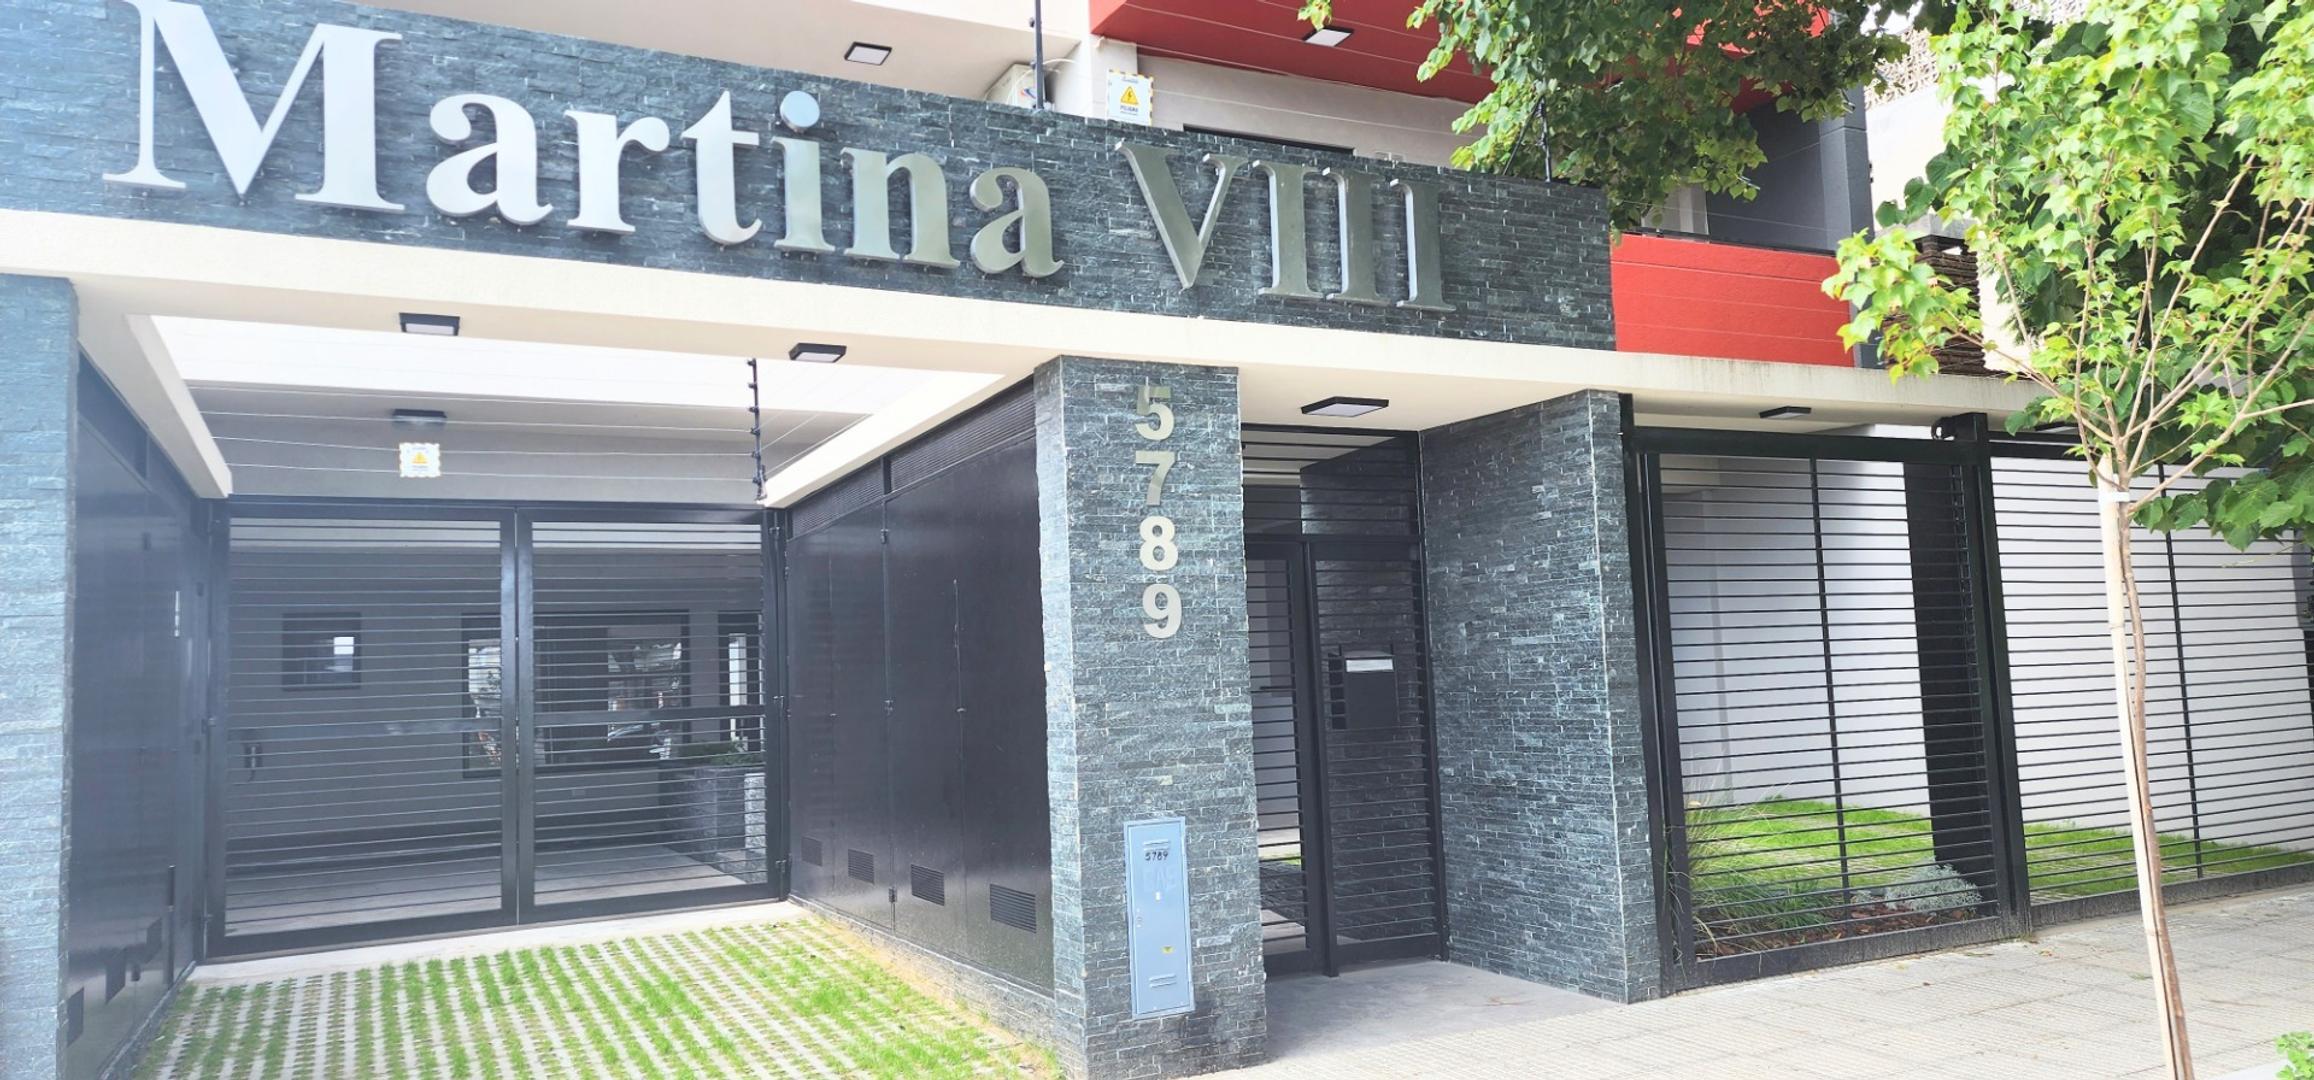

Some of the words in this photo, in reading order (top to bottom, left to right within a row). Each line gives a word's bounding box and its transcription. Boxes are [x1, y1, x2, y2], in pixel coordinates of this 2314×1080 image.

[102, 0, 1064, 278] Martina
[1114, 139, 1456, 311] VIII
[1135, 385, 1182, 639] 5789
[1144, 850, 1169, 861] 5789
